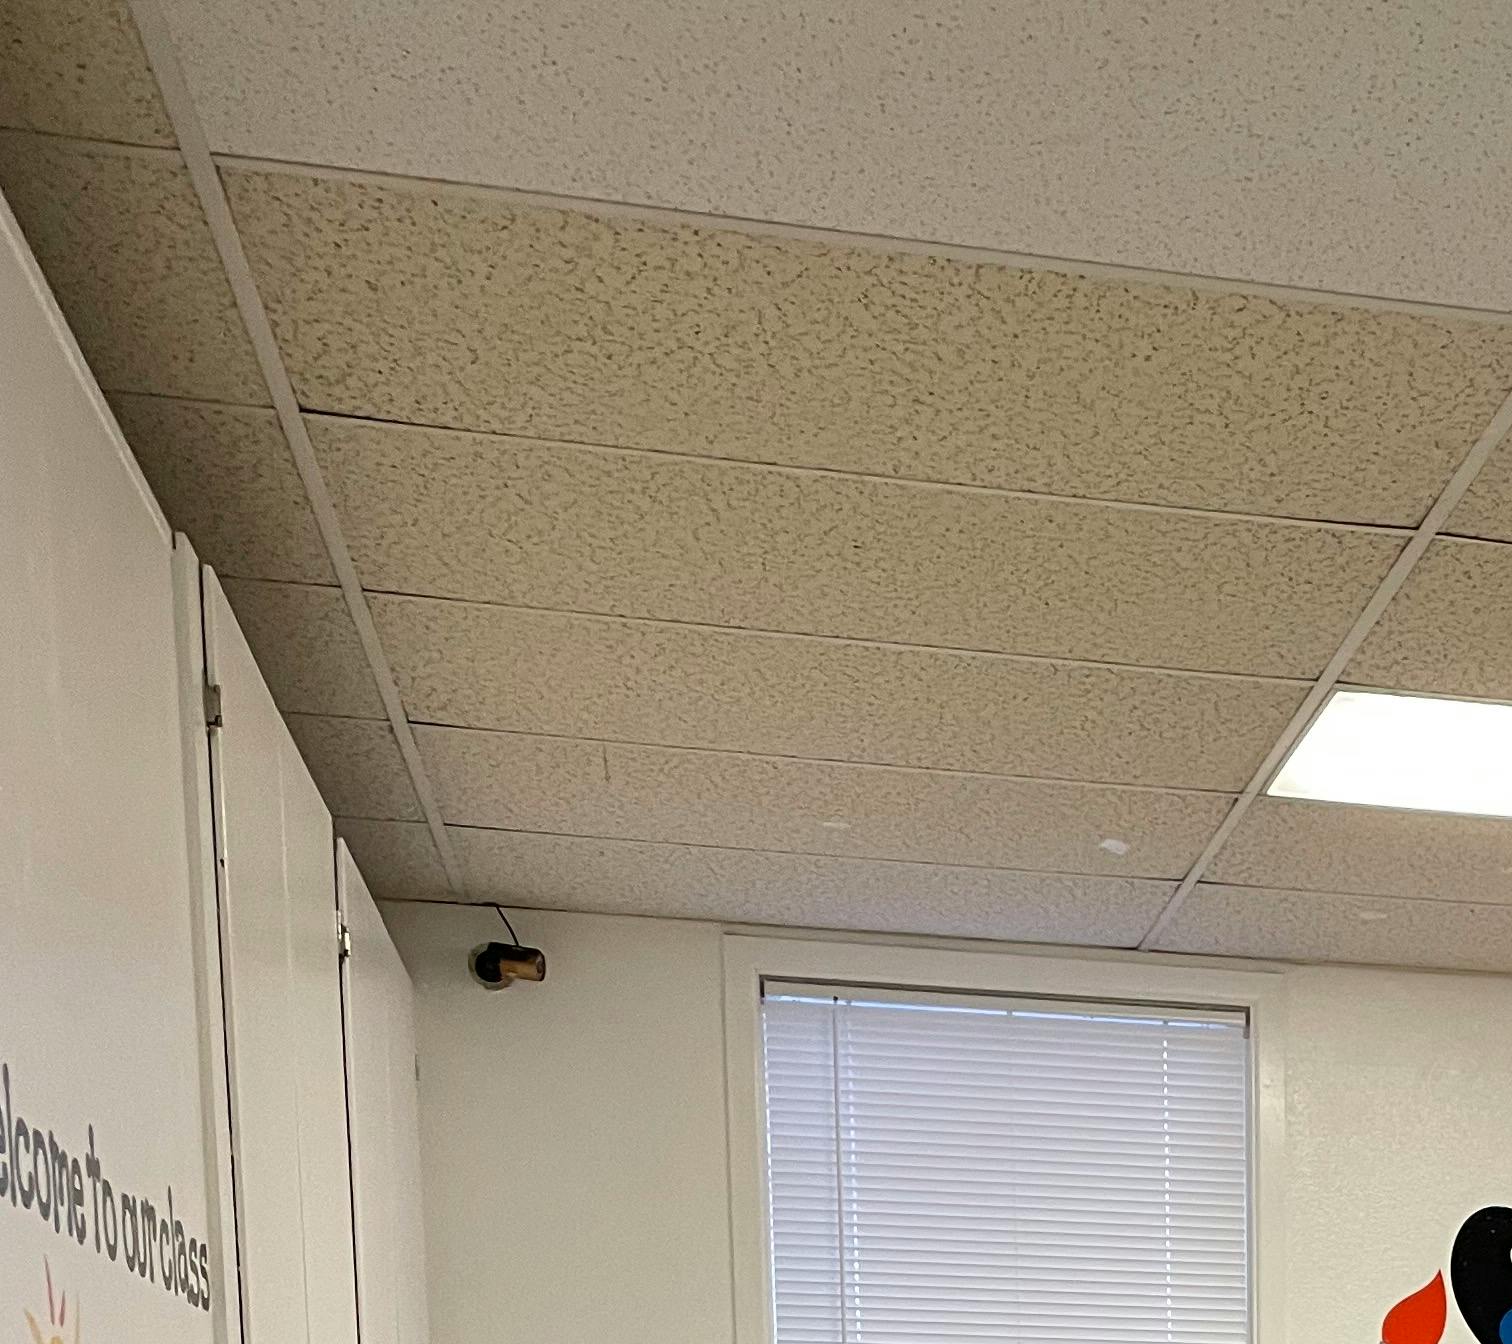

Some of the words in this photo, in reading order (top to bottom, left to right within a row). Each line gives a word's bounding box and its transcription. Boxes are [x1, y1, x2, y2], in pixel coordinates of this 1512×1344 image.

[86, 1123, 117, 1262] to
[121, 1192, 157, 1284] our
[159, 1184, 210, 1312] class
